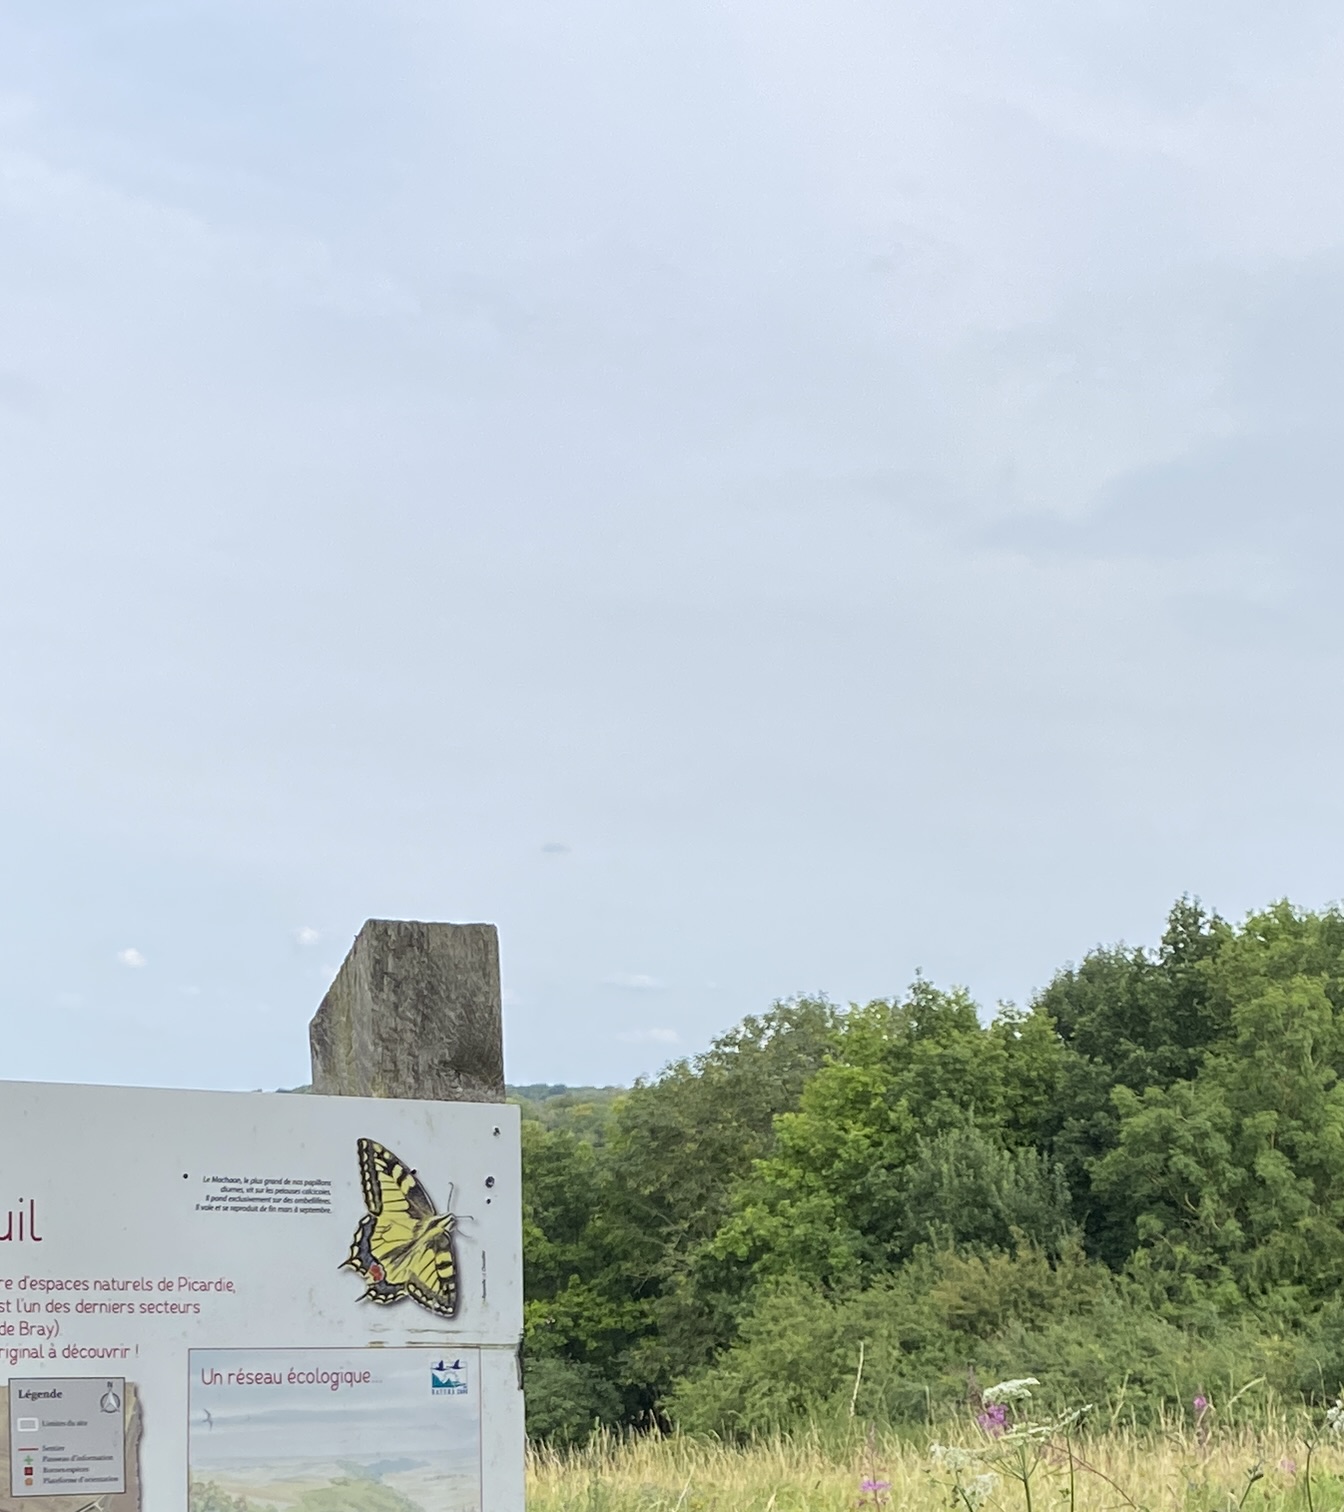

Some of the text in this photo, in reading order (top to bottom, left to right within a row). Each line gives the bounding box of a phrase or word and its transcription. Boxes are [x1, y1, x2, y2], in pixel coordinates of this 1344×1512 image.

[17, 1275, 90, 1295] d'espaces
[93, 1276, 154, 1292] naturels
[157, 1276, 174, 1292] de
[16, 1298, 41, 1314] l'un
[45, 1298, 71, 1314] des
[75, 1298, 135, 1314] derniers
[139, 1300, 201, 1314] secteurs
[201, 1368, 223, 1385] Un
[227, 1367, 282, 1385] réseau
[18, 1387, 63, 1402] Légende
